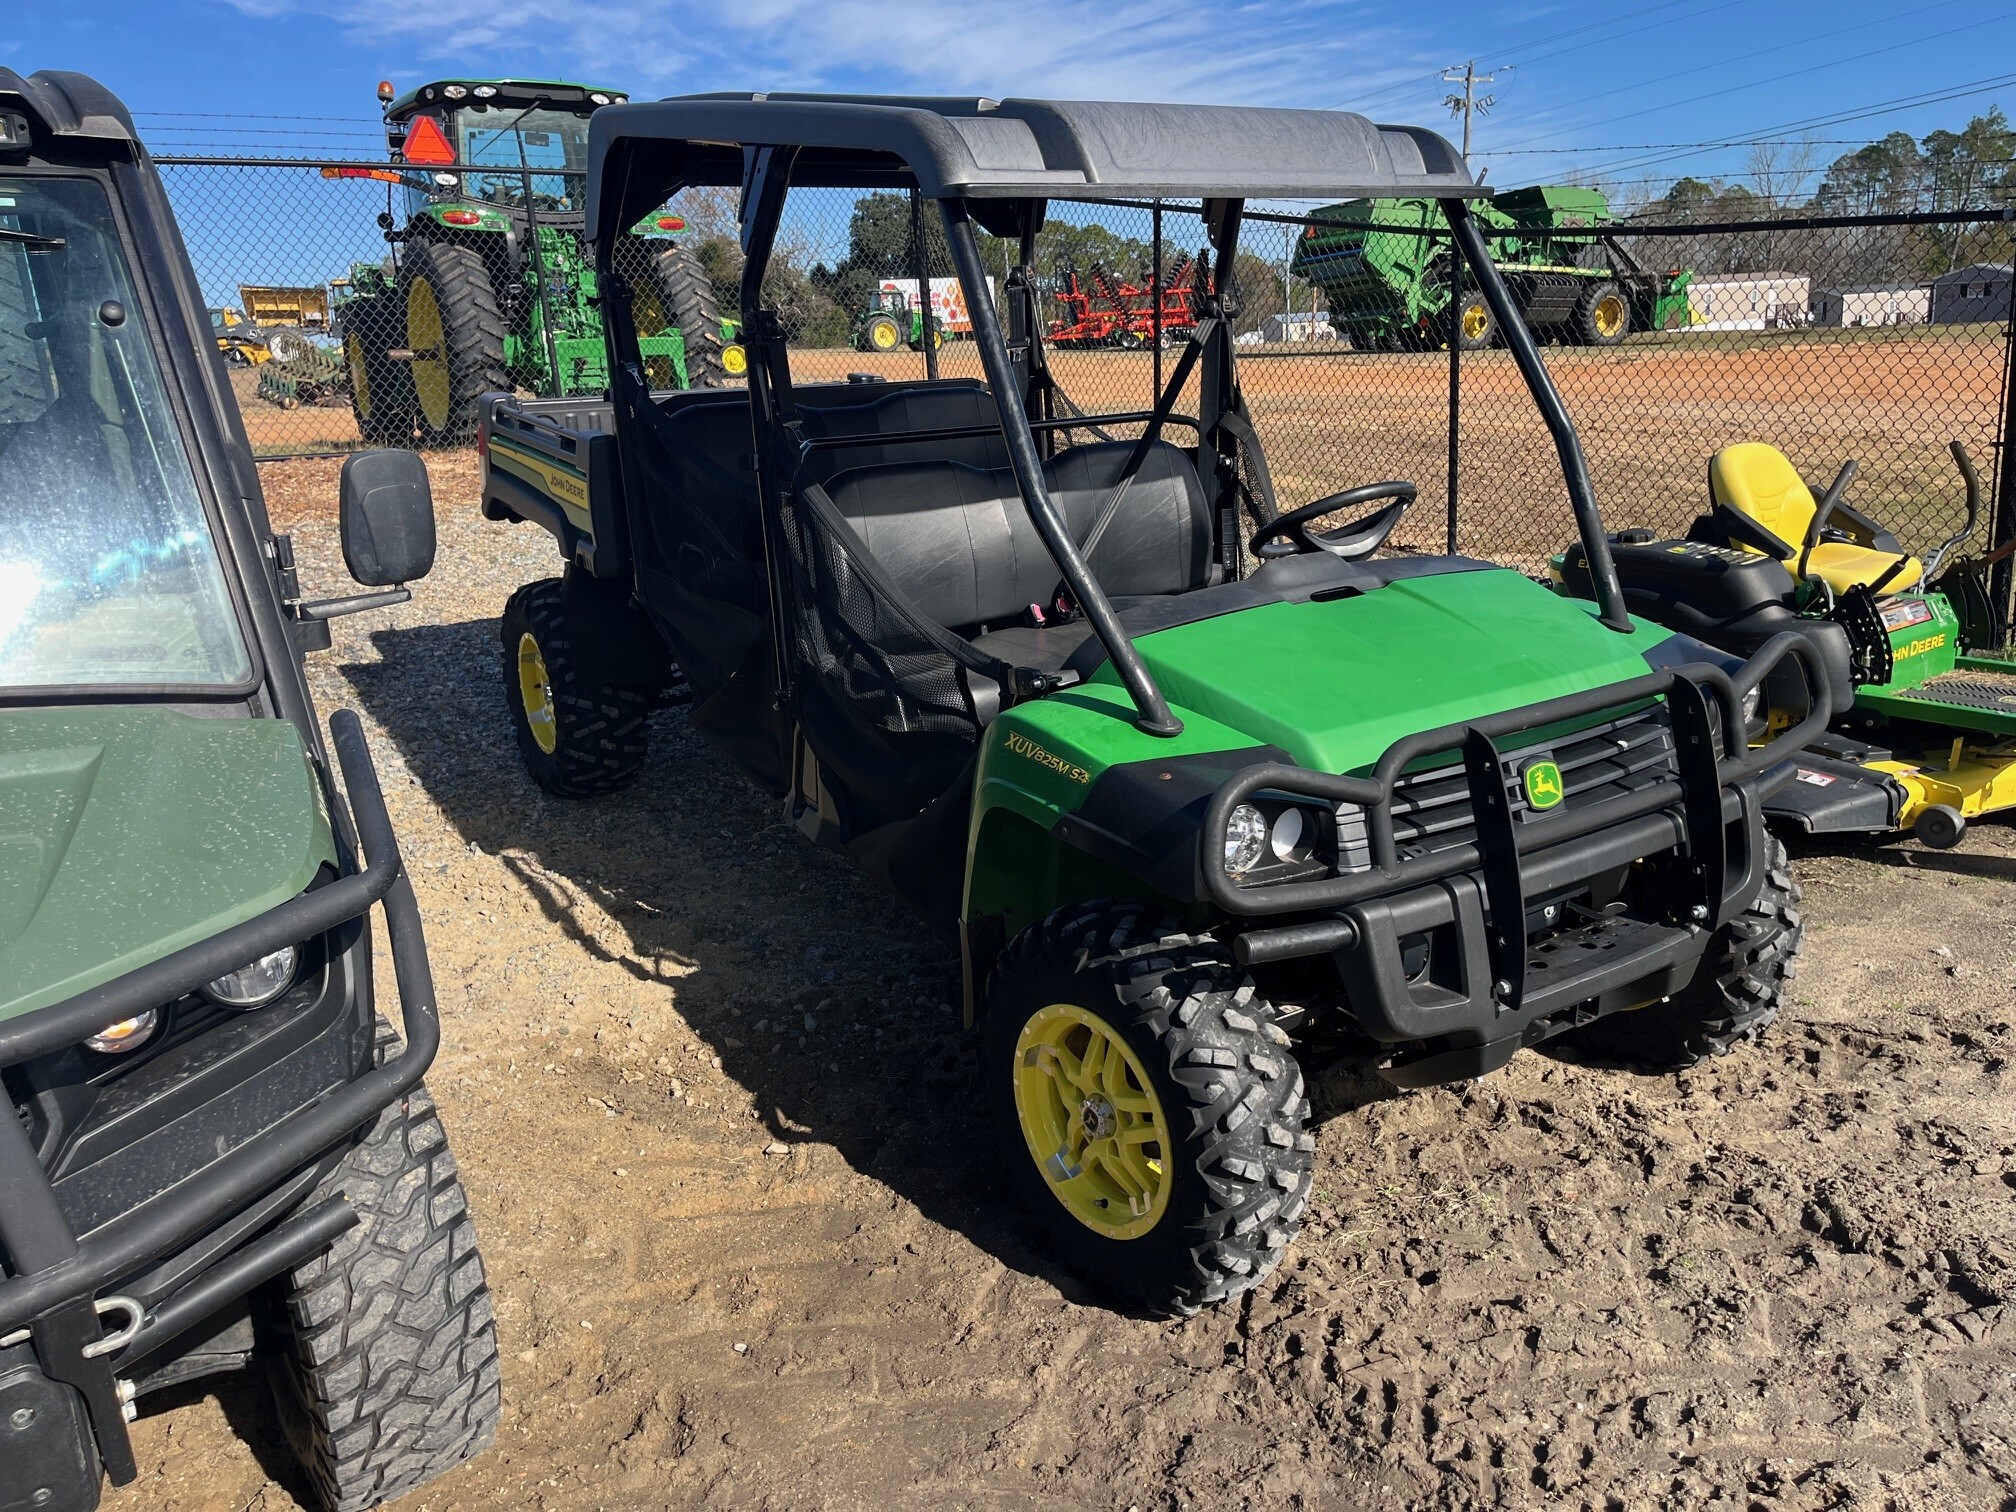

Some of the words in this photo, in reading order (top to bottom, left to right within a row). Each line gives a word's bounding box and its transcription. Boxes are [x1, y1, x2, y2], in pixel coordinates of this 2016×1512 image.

[551, 473, 565, 491] JOHN
[565, 479, 585, 500] DEERE
[1910, 633, 1945, 656] DEERE
[1004, 732, 1070, 774] XUV825M
[1069, 768, 1090, 784] S4
